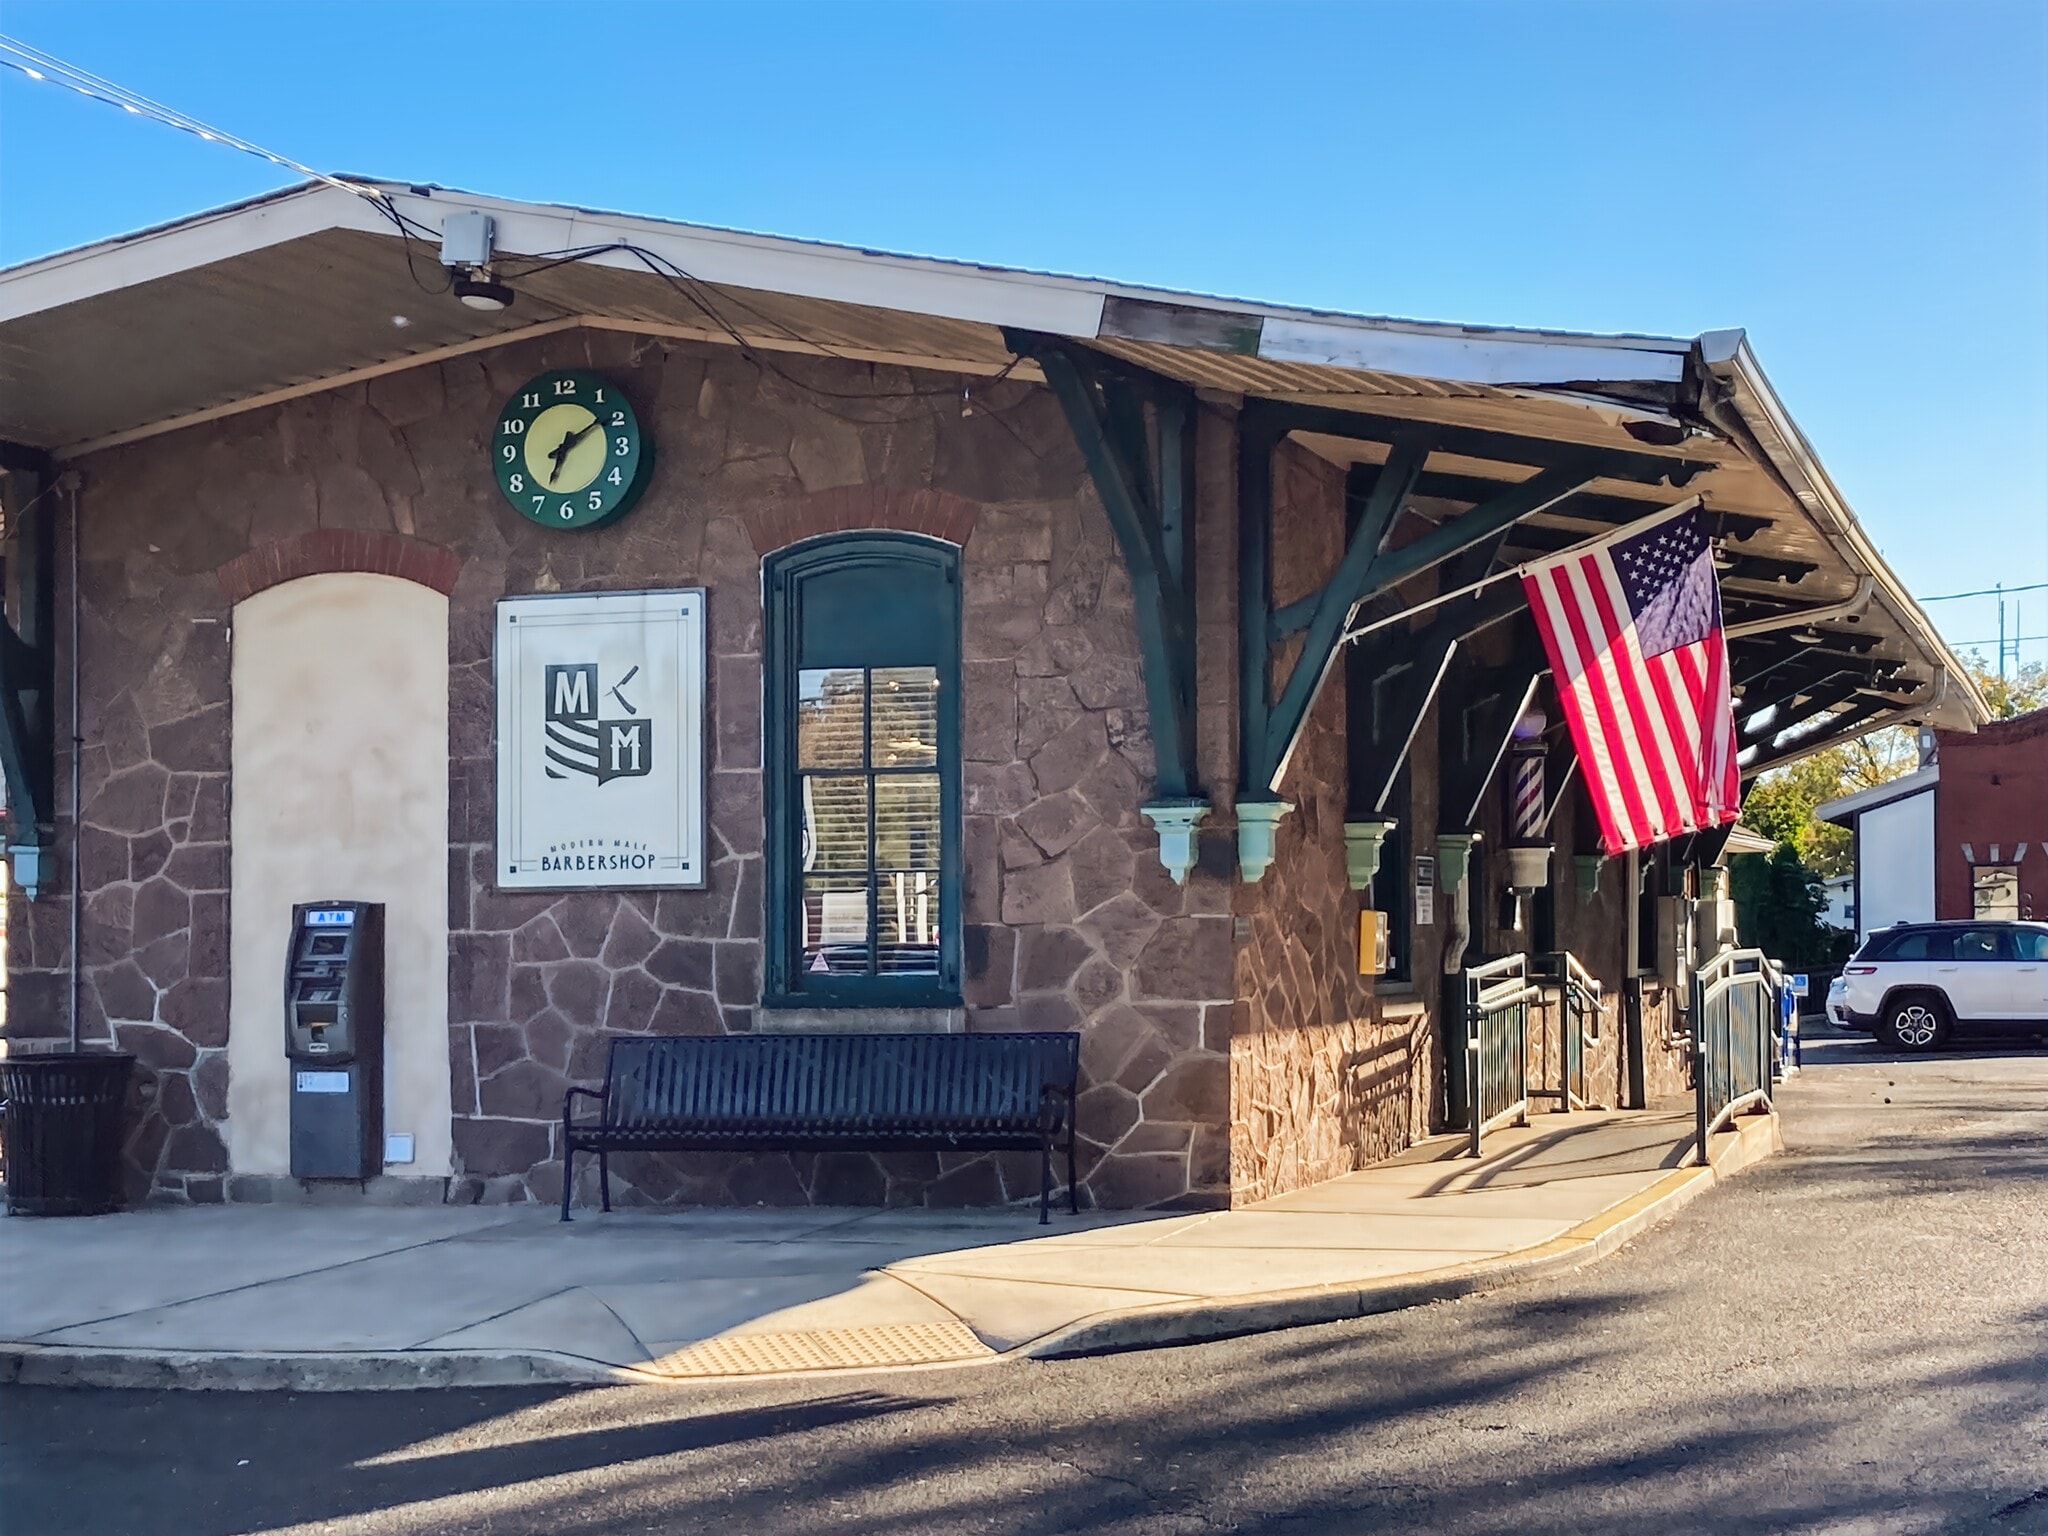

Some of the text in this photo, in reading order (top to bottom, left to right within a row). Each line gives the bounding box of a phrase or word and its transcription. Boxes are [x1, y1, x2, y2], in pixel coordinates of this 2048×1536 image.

[553, 379, 576, 395] 12
[595, 389, 605, 403] 1
[522, 393, 541, 408] 11
[502, 419, 524, 434] 10
[611, 411, 625, 426] 2
[503, 445, 516, 463] 9
[615, 437, 629, 456] 3
[509, 474, 524, 493] 8
[607, 466, 622, 485] 4
[532, 495, 545, 514] 7
[588, 491, 602, 510] 5
[559, 501, 574, 520] 6
[554, 671, 589, 714] M
[610, 725, 642, 771] M
[550, 839, 603, 853] MODERN
[541, 854, 655, 871] BARBERSHOP
[317, 912, 346, 922] ATM
